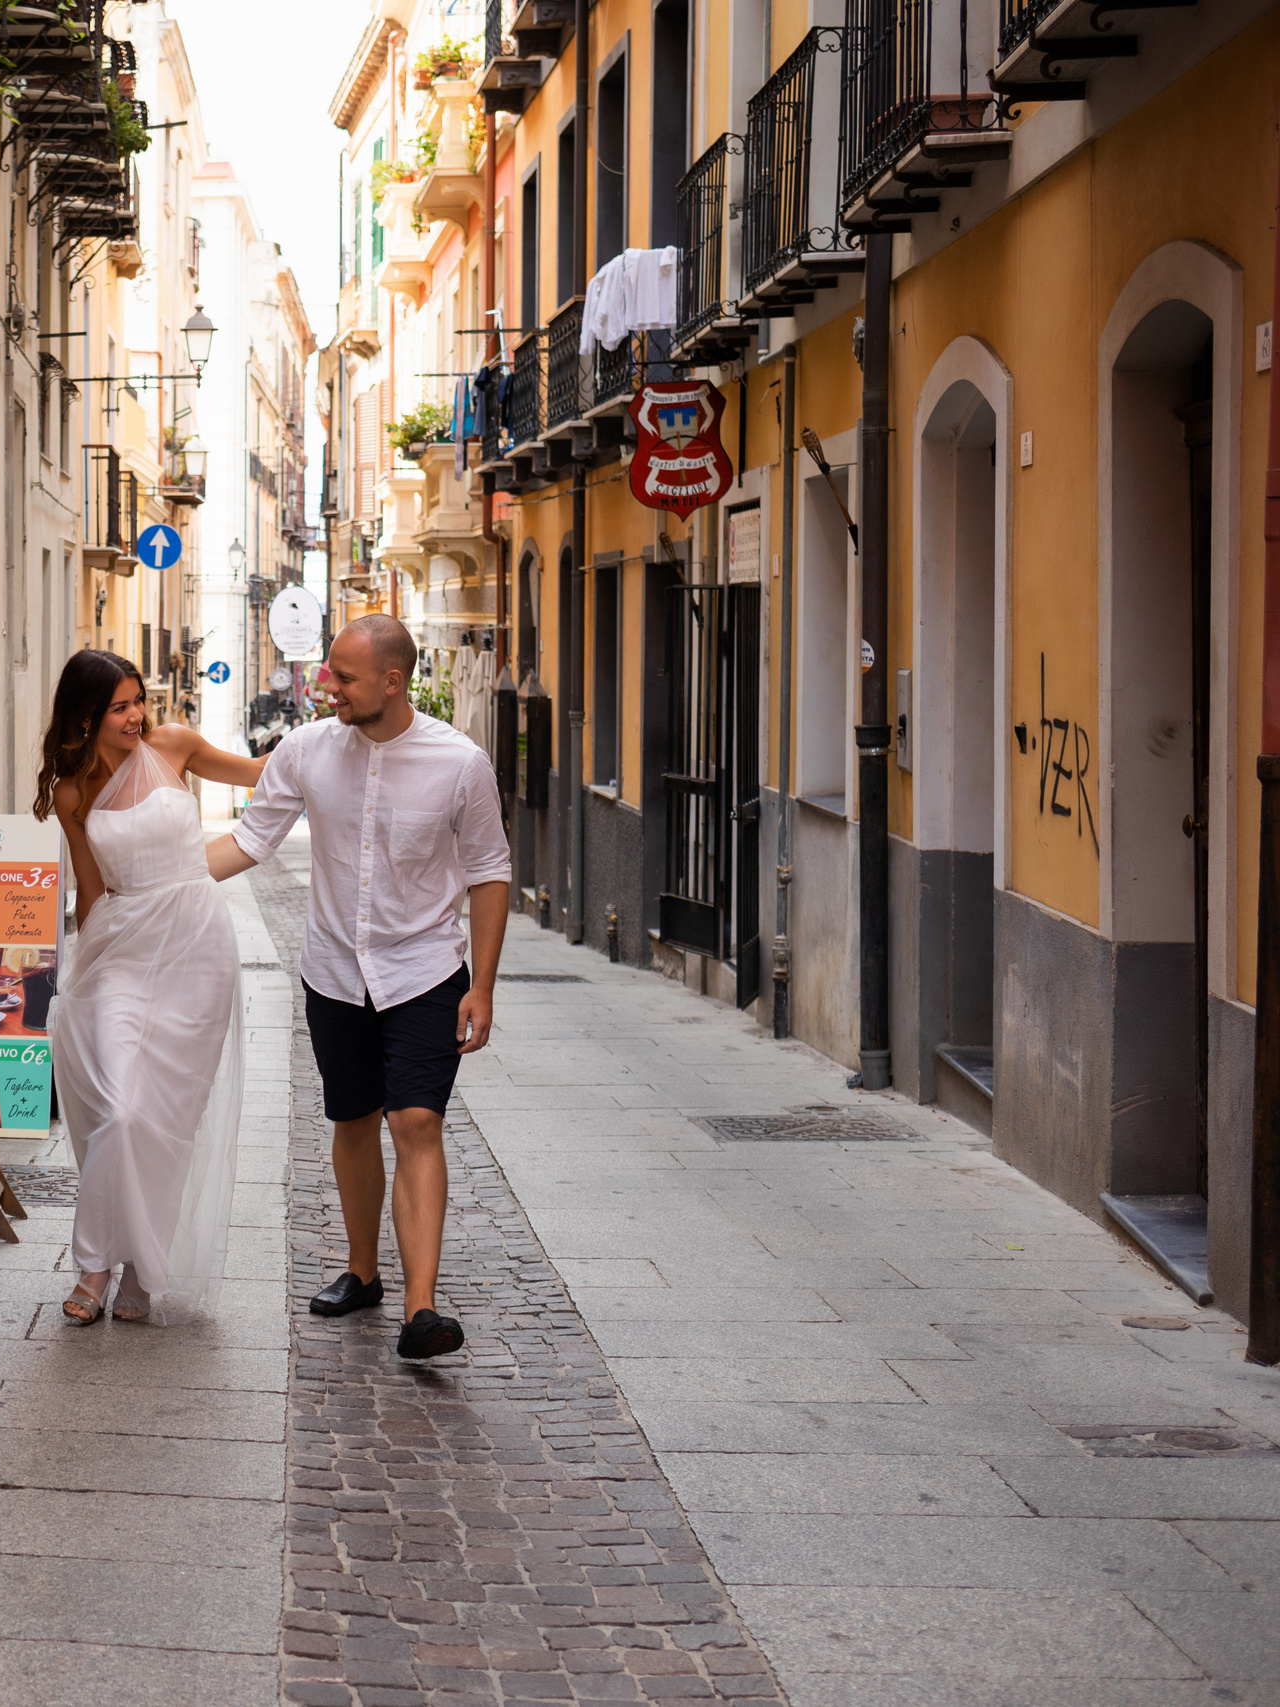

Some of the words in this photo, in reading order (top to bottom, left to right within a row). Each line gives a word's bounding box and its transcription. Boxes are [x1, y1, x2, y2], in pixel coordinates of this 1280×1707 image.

[1262, 339, 1270, 358] 60
[656, 482, 708, 496] CAGLIARI
[661, 497, 699, 507] MMIII
[5, 891, 45, 905] Cappuccino
[13, 910, 35, 920] Pasta
[5, 926, 41, 939] Spremuta
[4, 1078, 44, 1095] Tagliere
[8, 1105, 38, 1117] Drink
